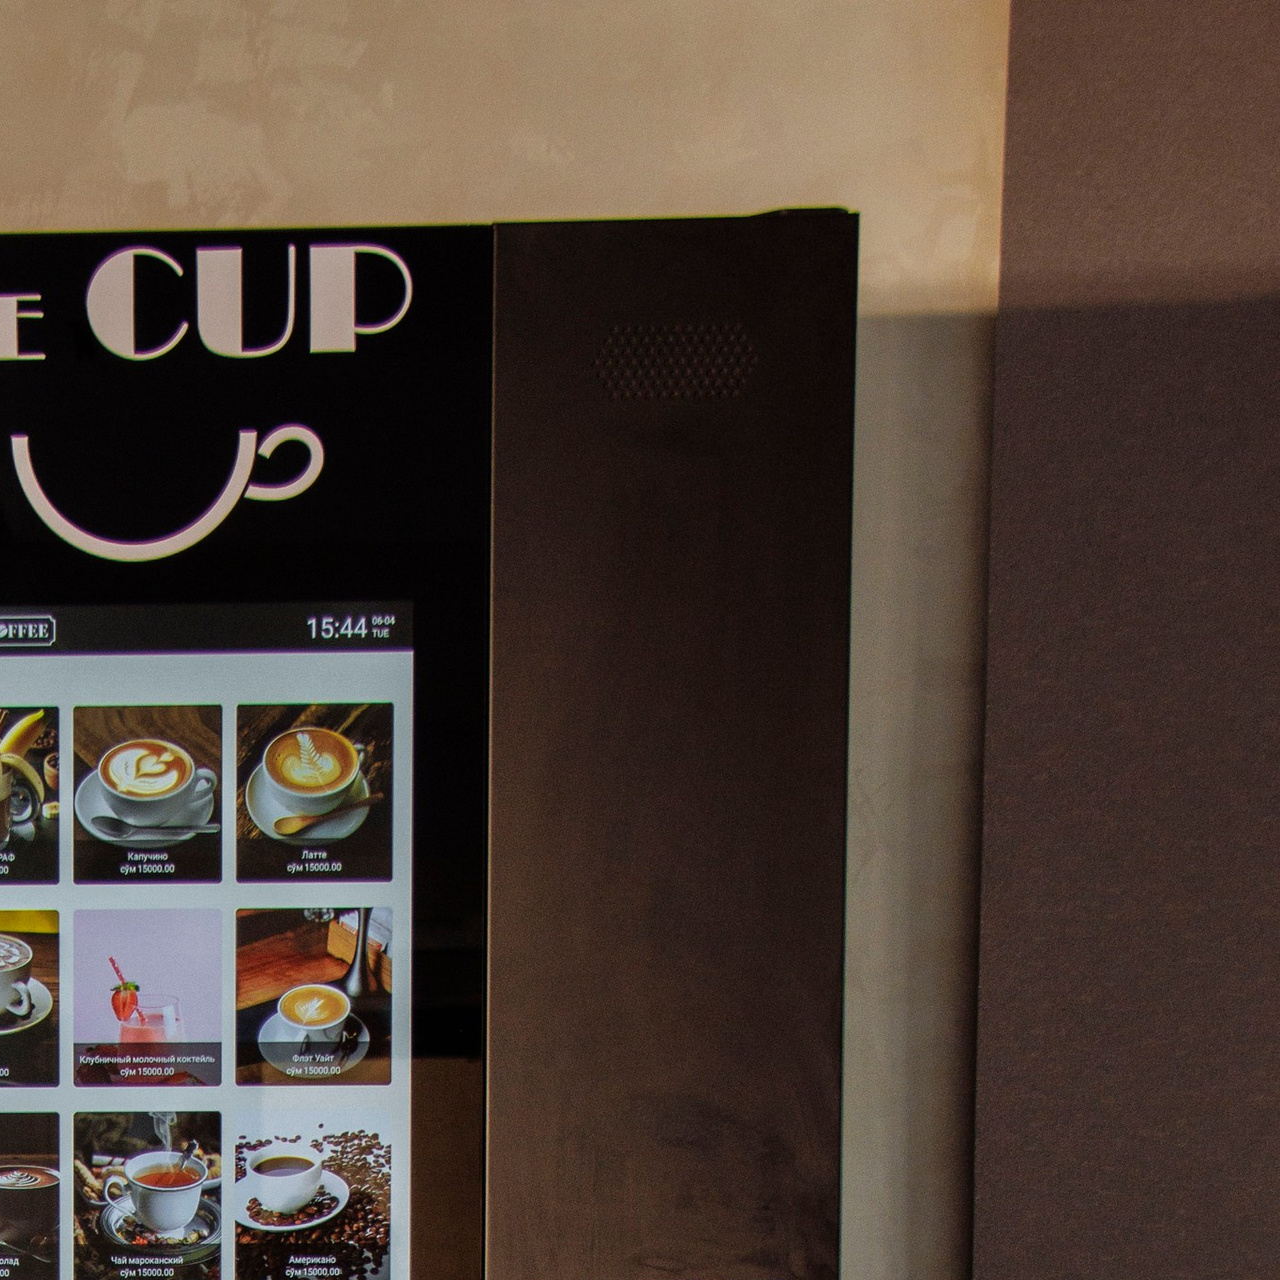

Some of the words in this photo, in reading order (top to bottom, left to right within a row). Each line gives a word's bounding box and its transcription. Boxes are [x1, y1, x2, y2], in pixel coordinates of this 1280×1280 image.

[86, 244, 413, 361] CUP
[372, 616, 396, 625] 06-04
[307, 616, 367, 639] 15:44
[372, 629, 389, 638] TUE
[128, 853, 168, 862] Капучино
[302, 851, 327, 860] Латте
[138, 864, 175, 873] 15000.00
[305, 863, 342, 871] 15000.00
[80, 1056, 131, 1065] Клубничный
[292, 1054, 313, 1062] Флэт
[315, 1054, 334, 1062] Уайт
[138, 1068, 174, 1076] 15000.00
[111, 1256, 127, 1264] Чай
[128, 1256, 183, 1265] мароканский
[289, 1256, 336, 1264] Американо
